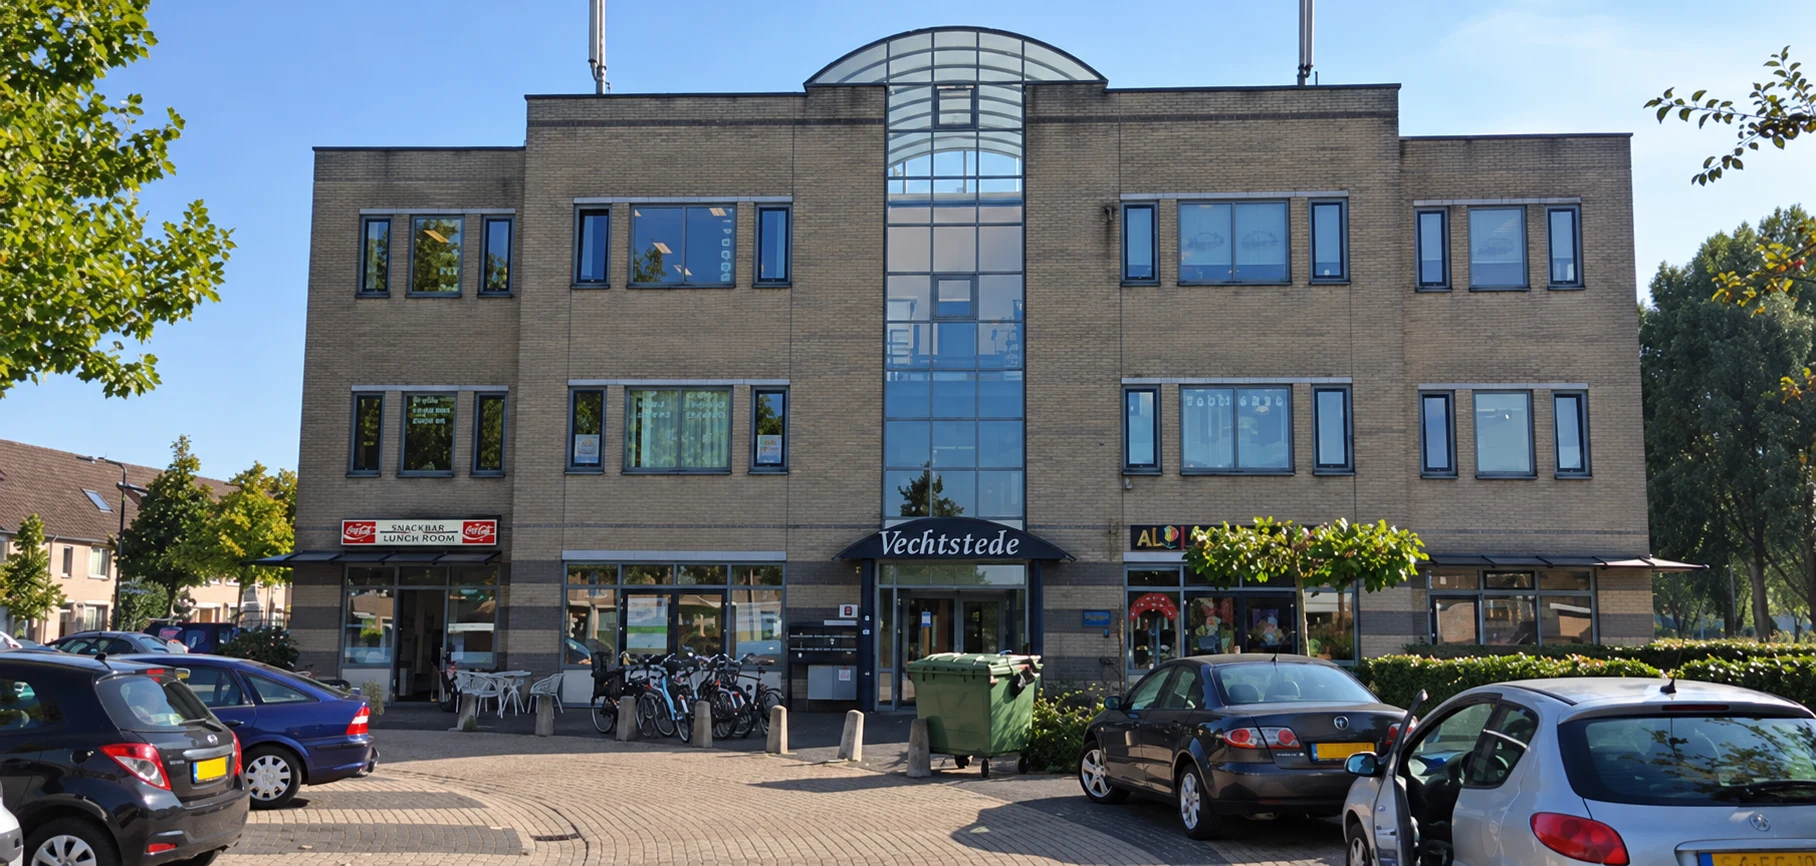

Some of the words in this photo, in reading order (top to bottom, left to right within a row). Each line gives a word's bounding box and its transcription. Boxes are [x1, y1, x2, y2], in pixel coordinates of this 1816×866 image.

[391, 524, 445, 532] SNACKBAR
[383, 534, 419, 542] LUNCH
[422, 534, 455, 542] ROOM
[878, 529, 1020, 555] Vechtstede
